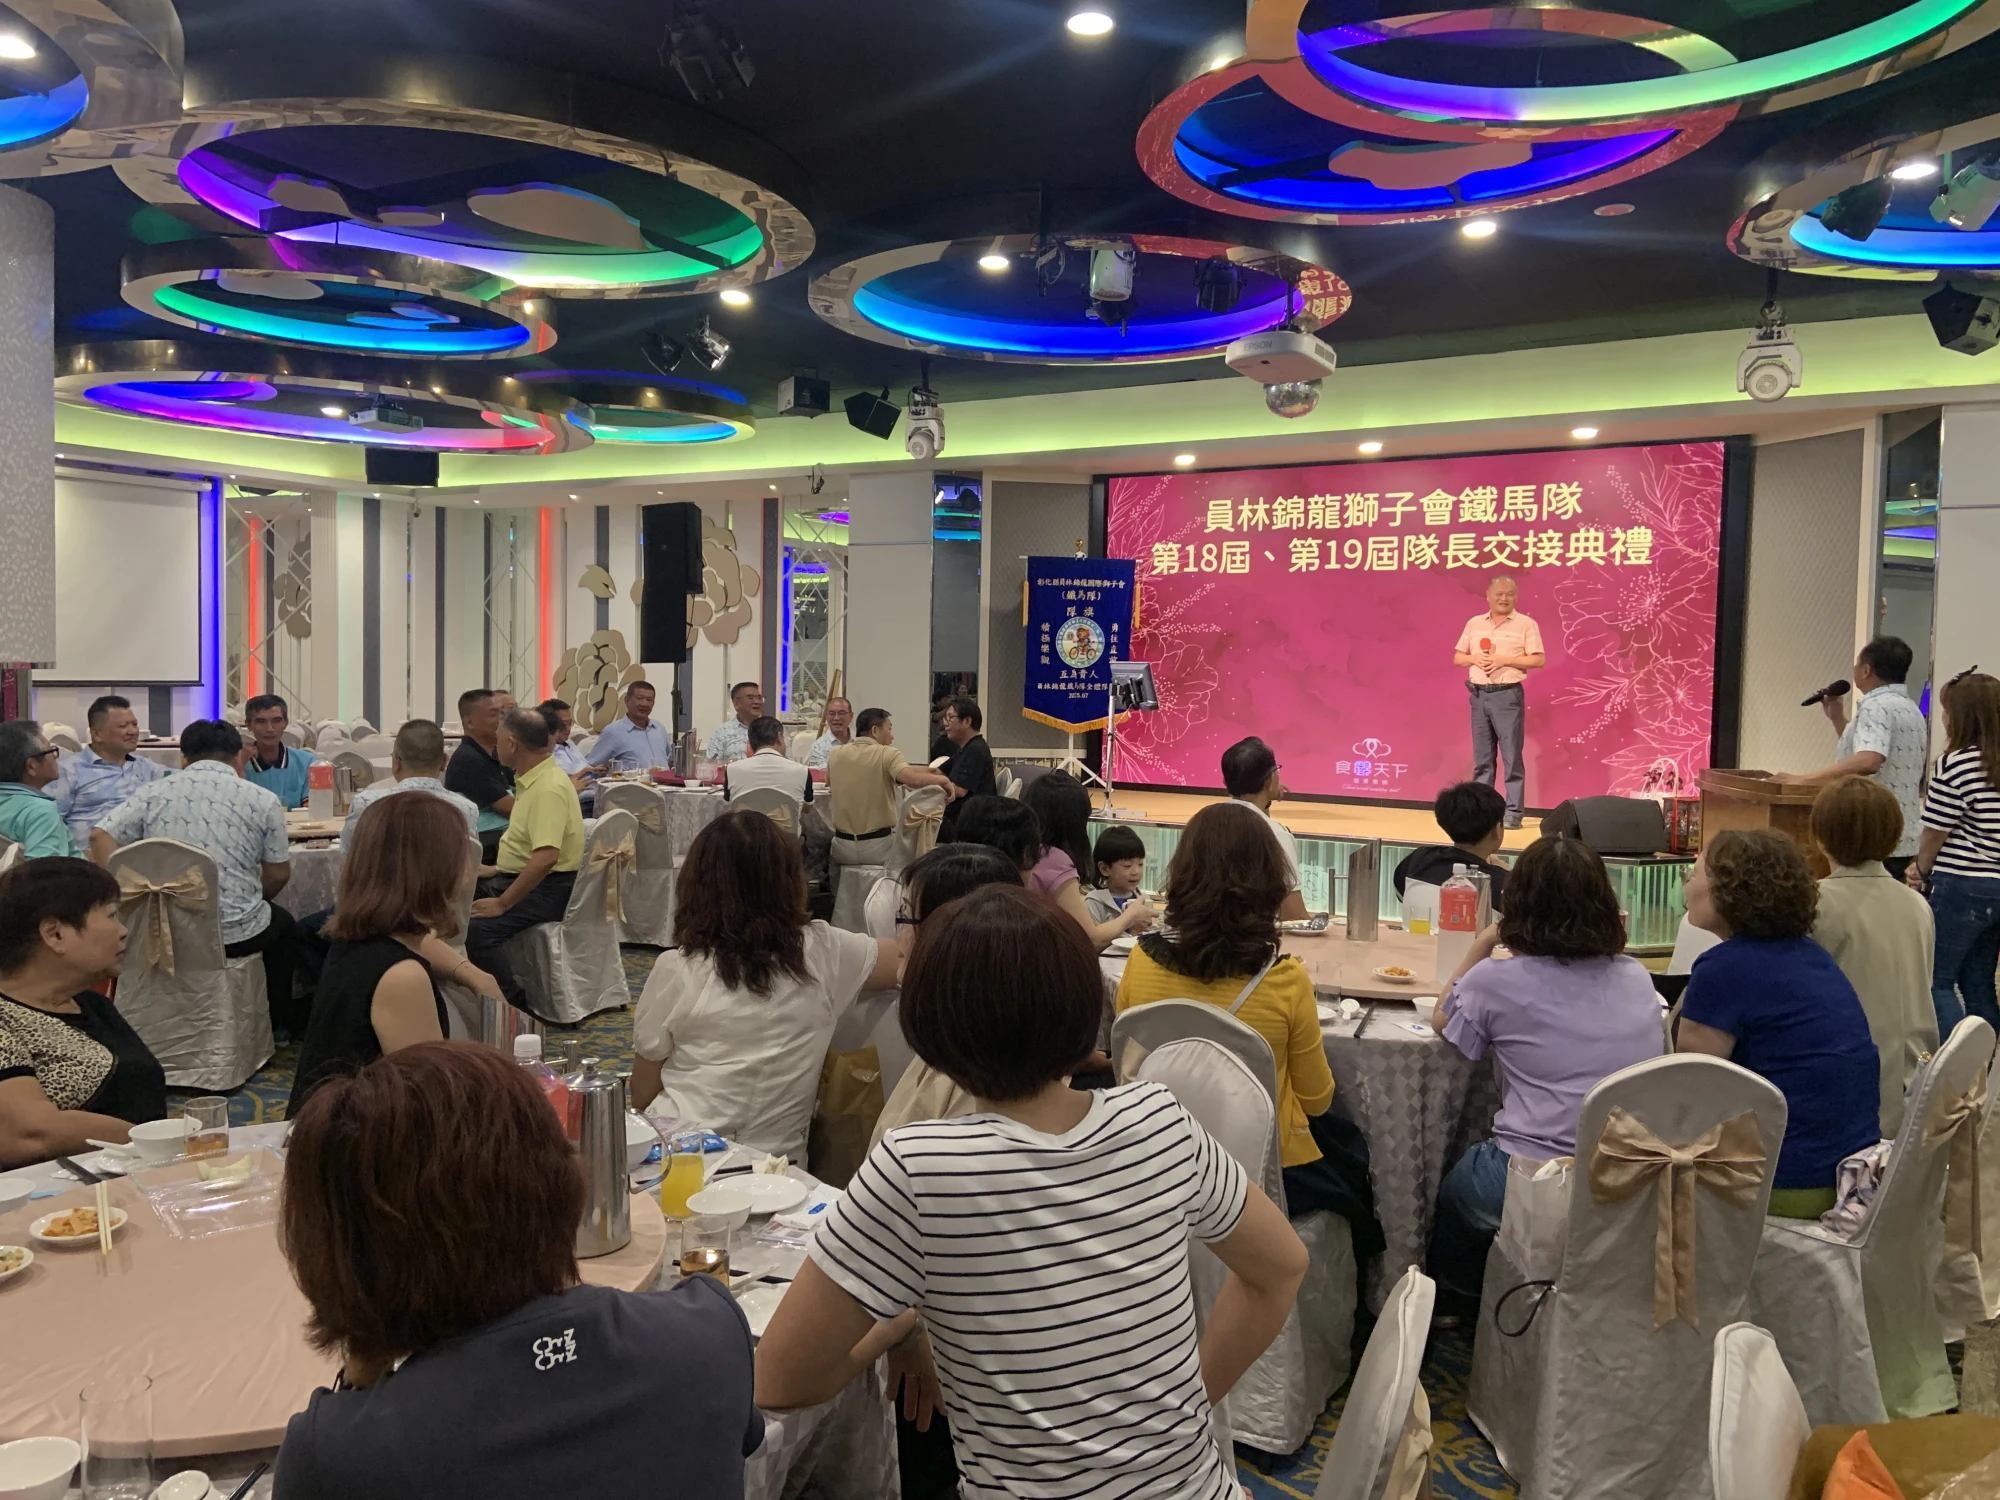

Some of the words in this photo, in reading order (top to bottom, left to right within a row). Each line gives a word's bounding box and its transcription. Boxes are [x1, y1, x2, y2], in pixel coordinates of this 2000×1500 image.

[1243, 340, 1272, 351] EPSON
[1203, 481, 1584, 533] 員林錦龍獅子會鐵馬隊
[1151, 525, 1653, 576] 第18屆、第19屆隊長交接典禮
